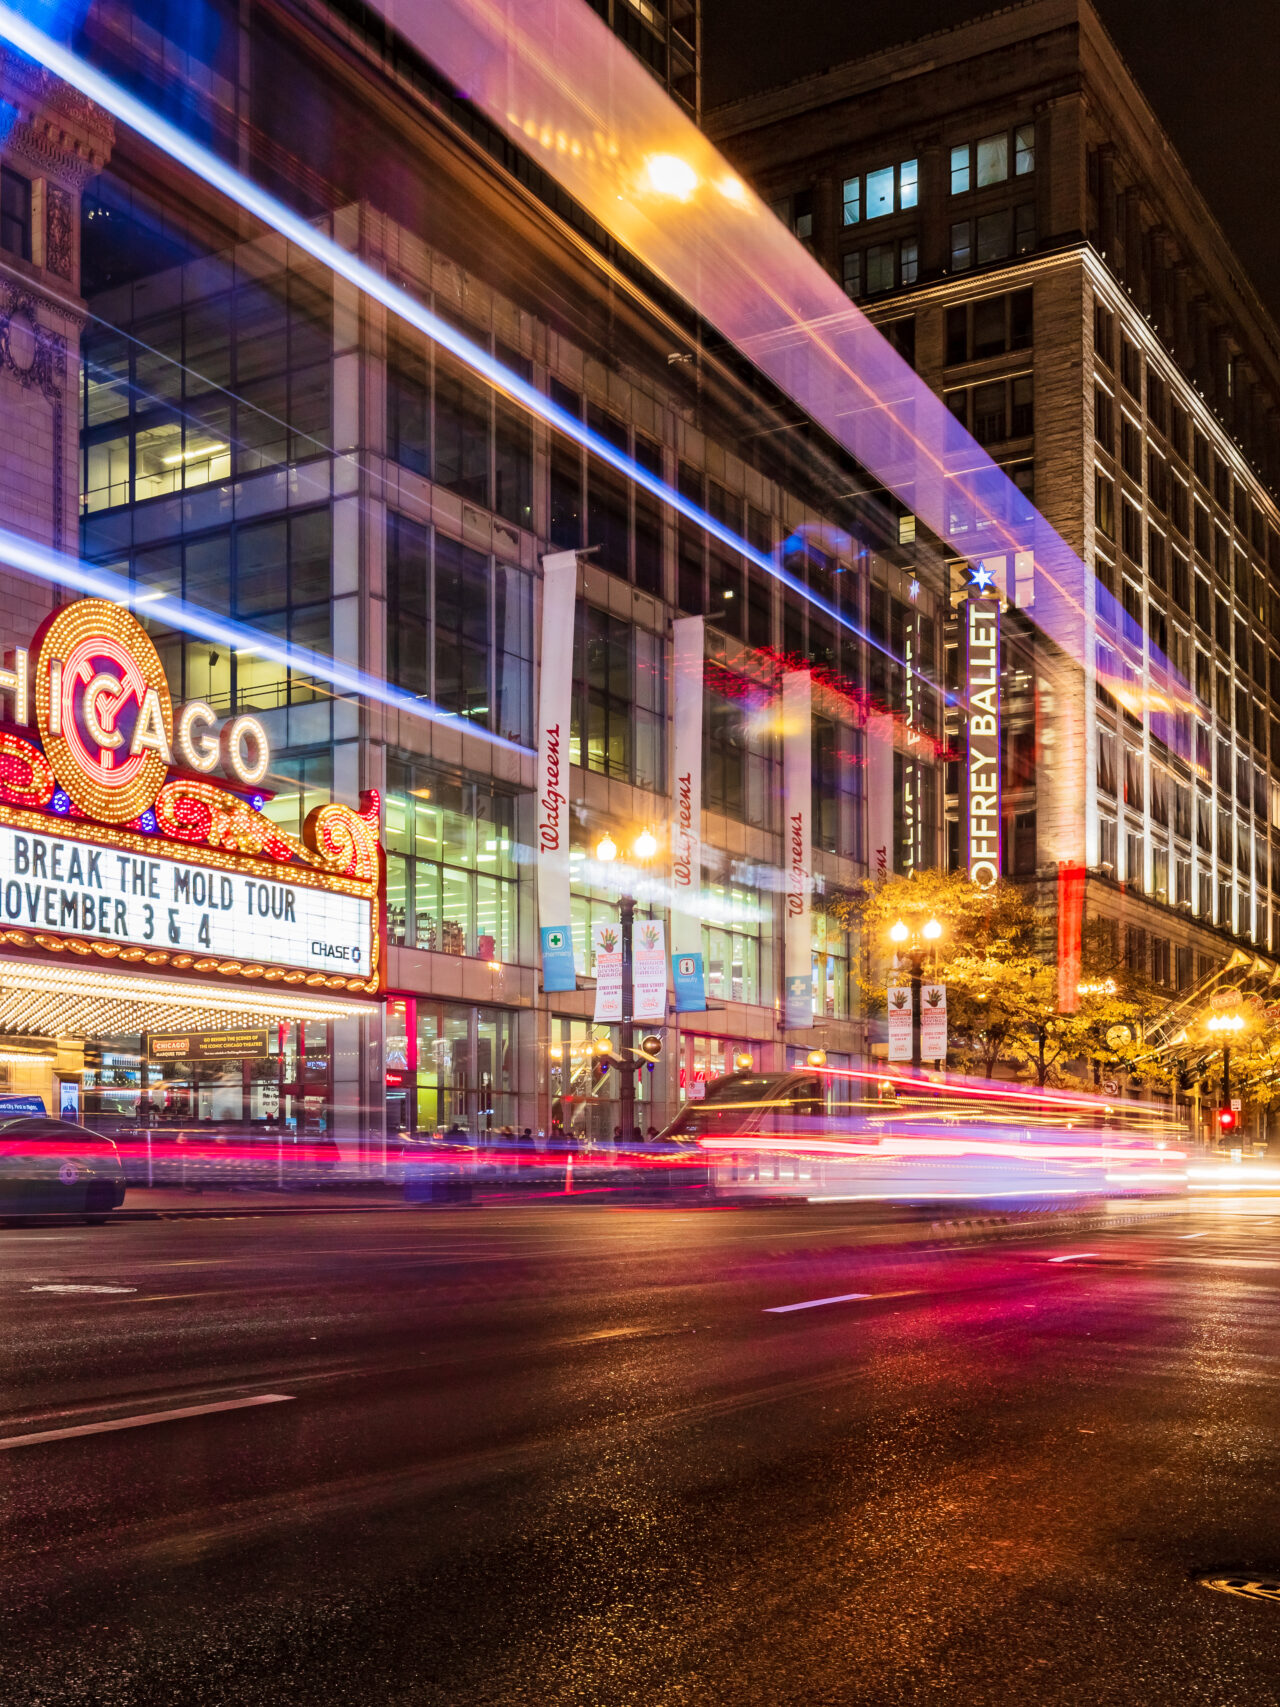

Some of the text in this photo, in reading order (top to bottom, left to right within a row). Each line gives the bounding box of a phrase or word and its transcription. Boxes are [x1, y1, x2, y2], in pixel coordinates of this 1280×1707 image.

[970, 604, 996, 736] BALLET
[541, 723, 561, 854] Walgreens
[674, 772, 692, 887] Walgreens
[14, 835, 103, 889] BREAK
[117, 855, 161, 900] THE
[174, 867, 234, 912] MOLD
[245, 880, 297, 924] TOUR
[788, 812, 803, 919] Walgreens
[143, 904, 155, 940] 3
[168, 908, 181, 944] &
[198, 913, 212, 949] 4
[311, 941, 351, 961] CHASE
